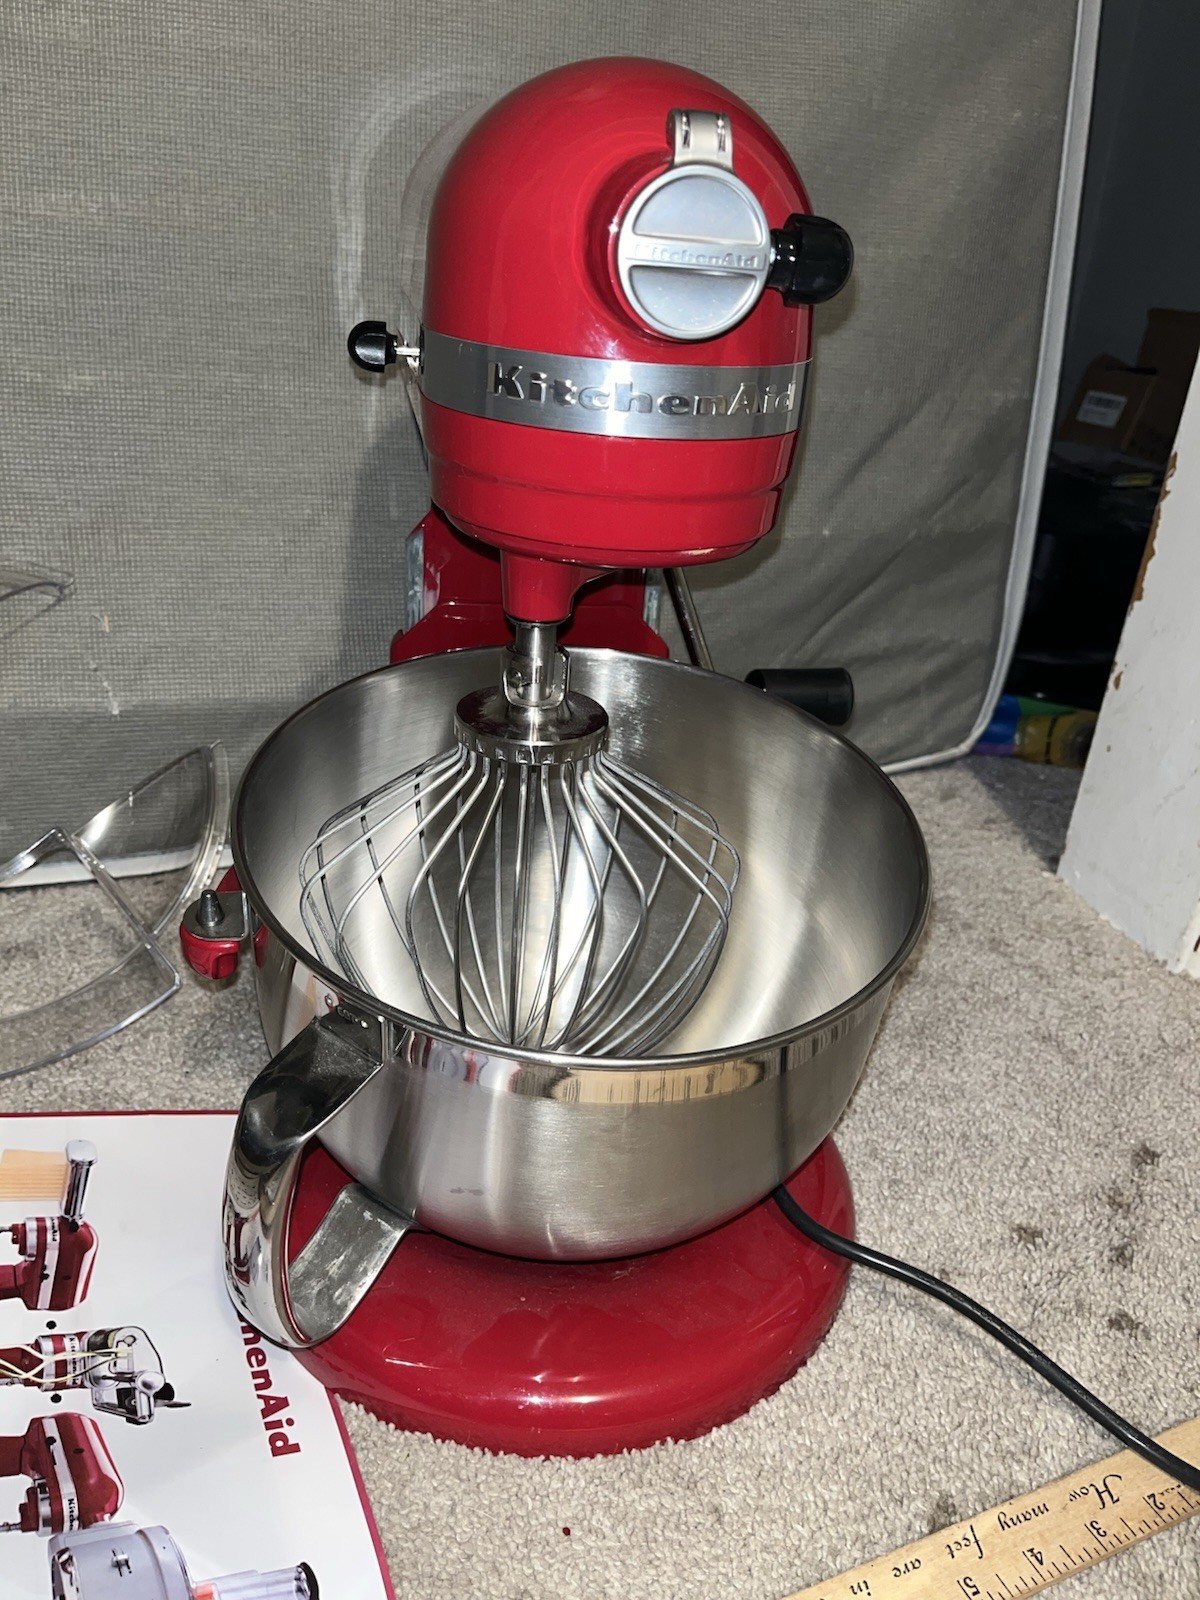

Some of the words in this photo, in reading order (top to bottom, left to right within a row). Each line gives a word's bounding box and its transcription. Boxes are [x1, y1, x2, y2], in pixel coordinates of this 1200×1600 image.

[634, 243, 759, 269] KitchenAid
[487, 361, 797, 416] KitchenAid
[1069, 1474, 1123, 1510] How
[1147, 1492, 1166, 1511] 2
[997, 1502, 1050, 1531] many
[1089, 1520, 1107, 1538] 3
[945, 1524, 984, 1559] feet
[1027, 1547, 1044, 1566] 4
[891, 1557, 922, 1578] are
[849, 1579, 872, 1597] in
[963, 1576, 981, 1597] 5
